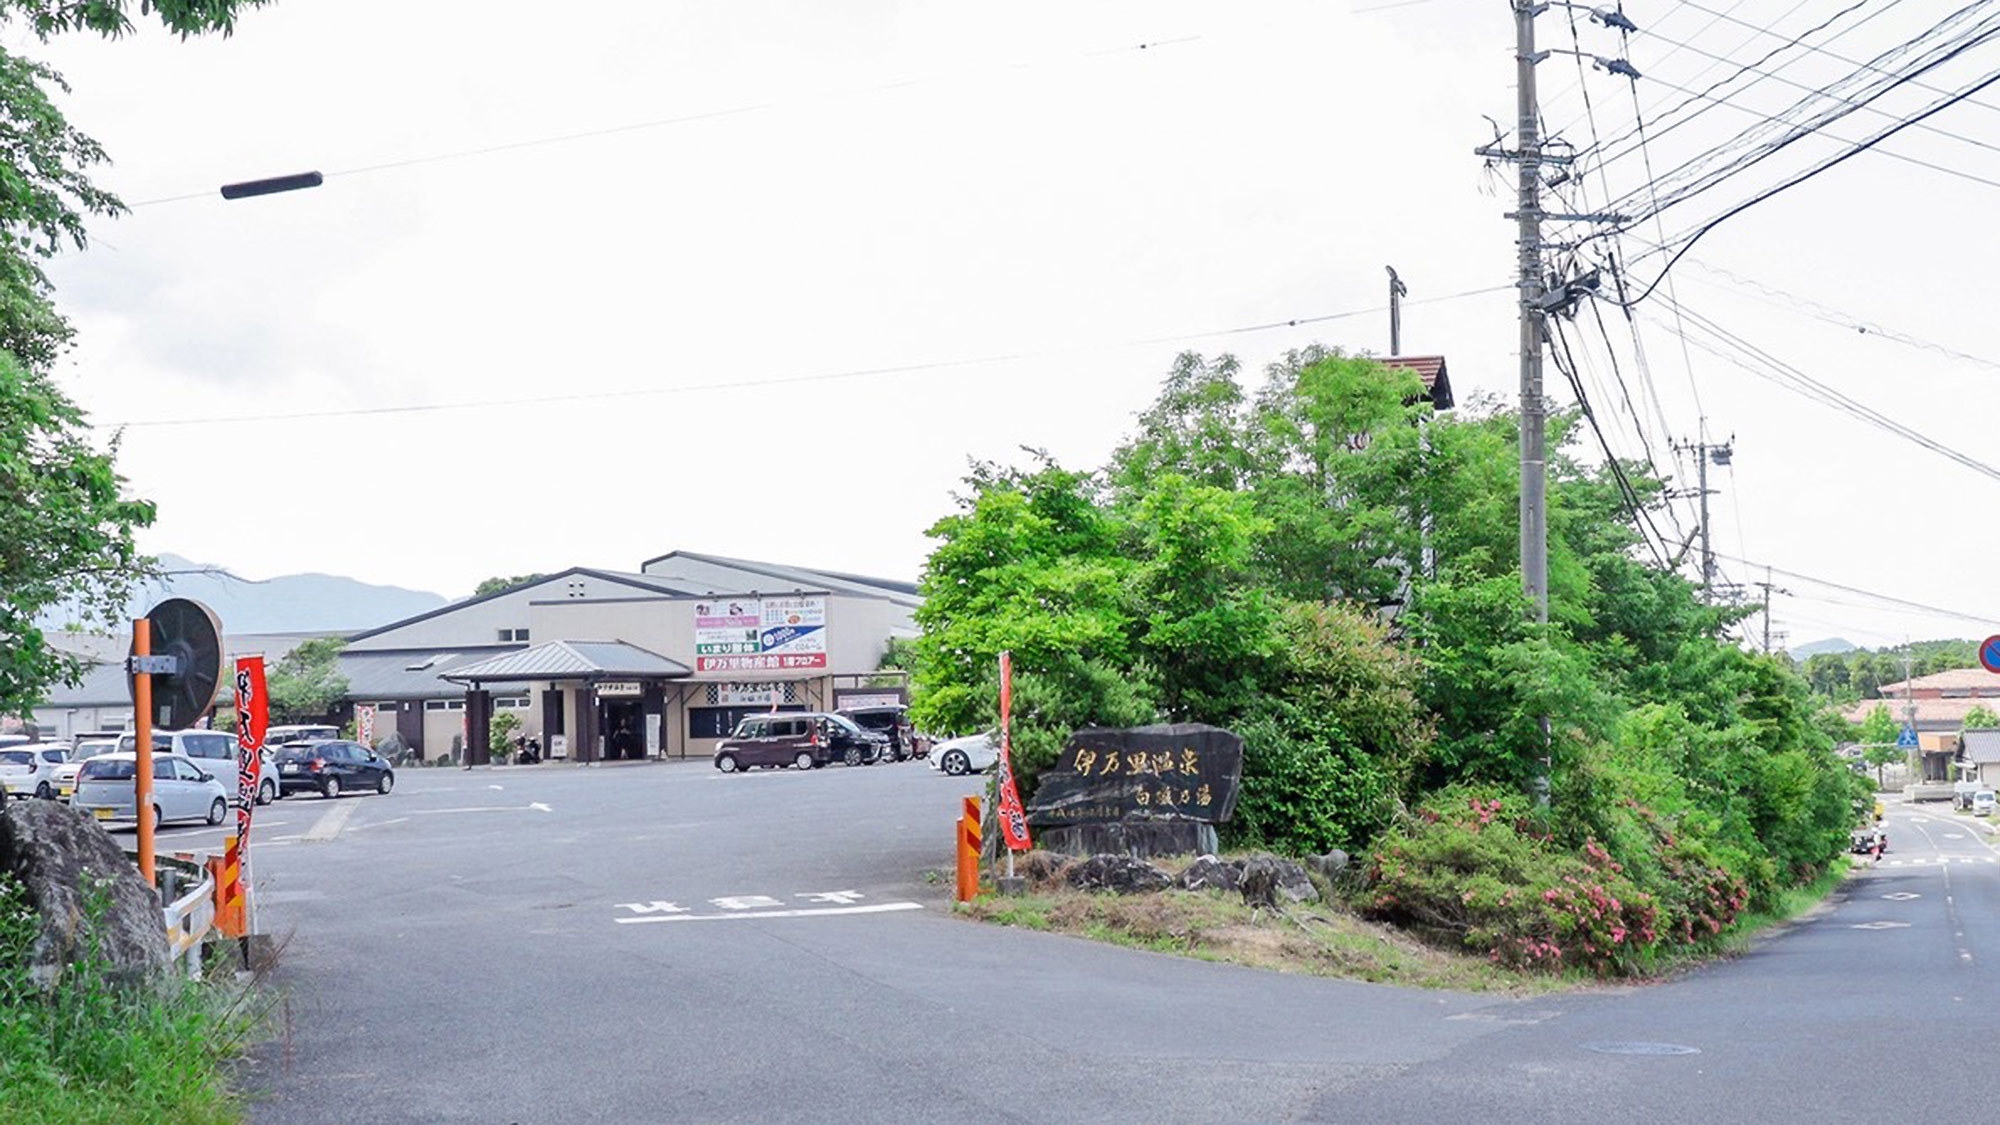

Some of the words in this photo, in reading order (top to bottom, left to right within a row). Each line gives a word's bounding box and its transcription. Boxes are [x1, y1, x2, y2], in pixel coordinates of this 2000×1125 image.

[703, 656, 780, 670] 伊万里物産館
[1073, 747, 1200, 778] 伊万里温泉
